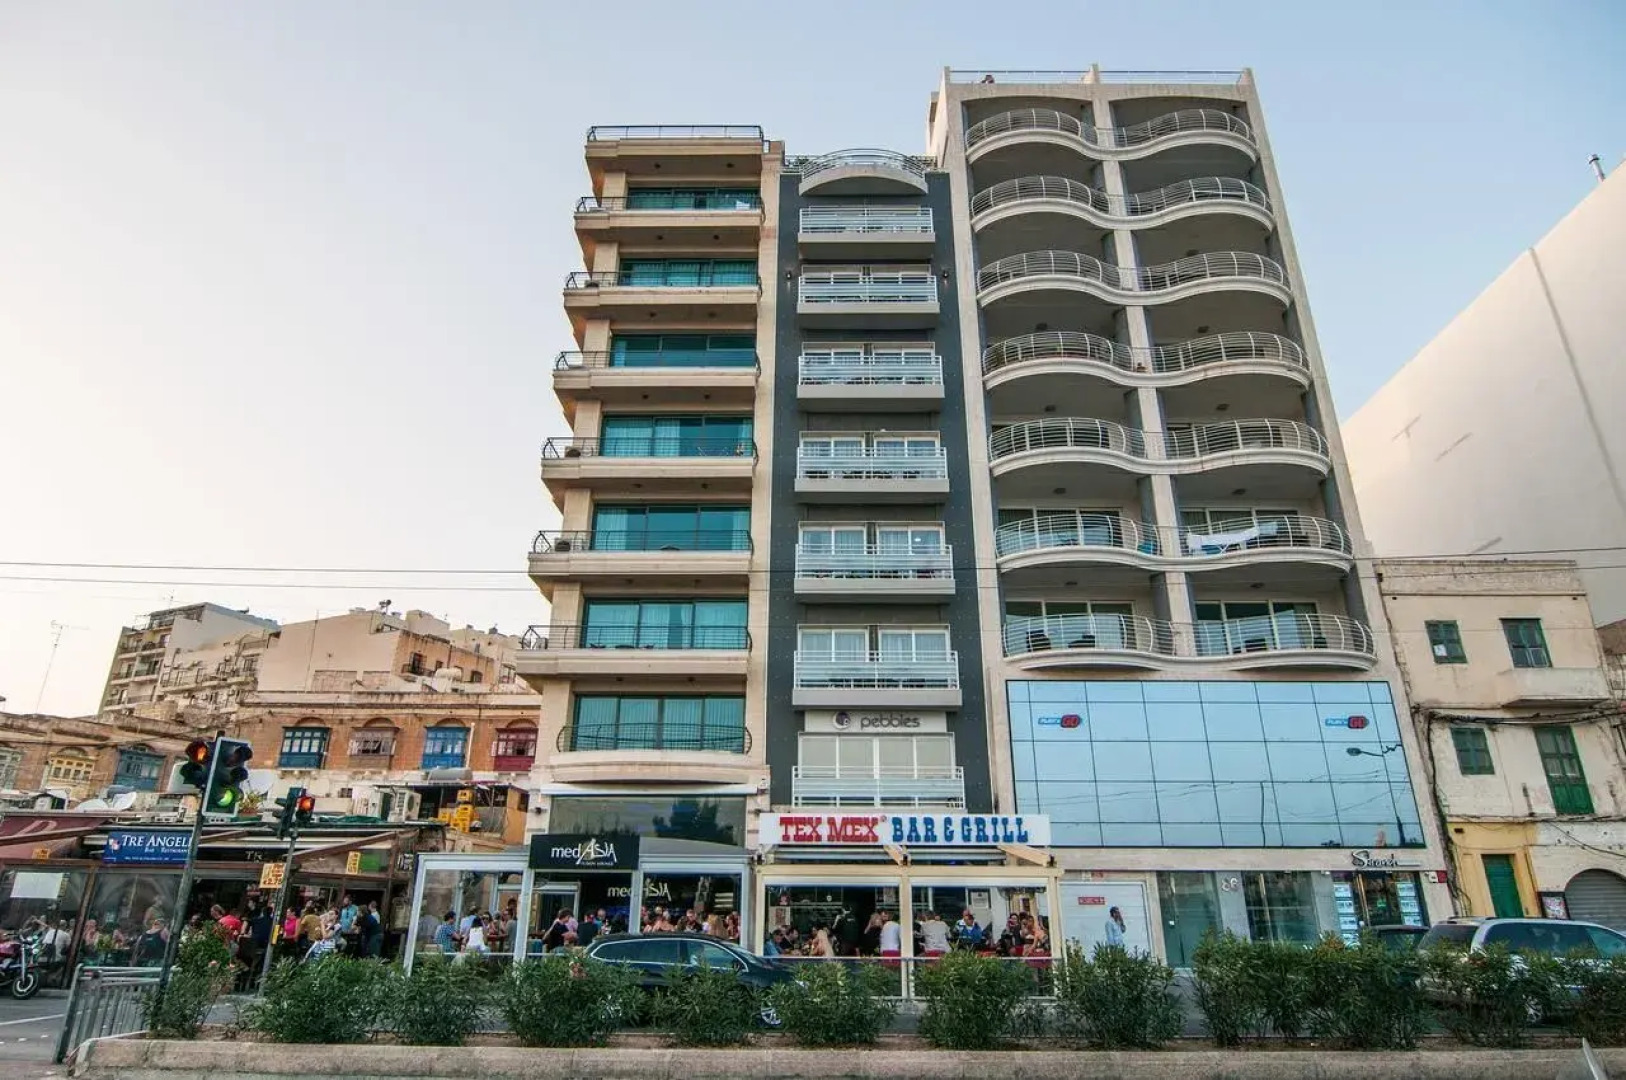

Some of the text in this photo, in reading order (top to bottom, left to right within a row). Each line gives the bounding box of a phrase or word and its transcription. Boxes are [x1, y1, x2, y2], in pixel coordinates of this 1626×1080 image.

[861, 713, 920, 730] pebbles
[779, 816, 1029, 842] TEX MEX BAR & GRILL
[121, 834, 145, 847] TRE
